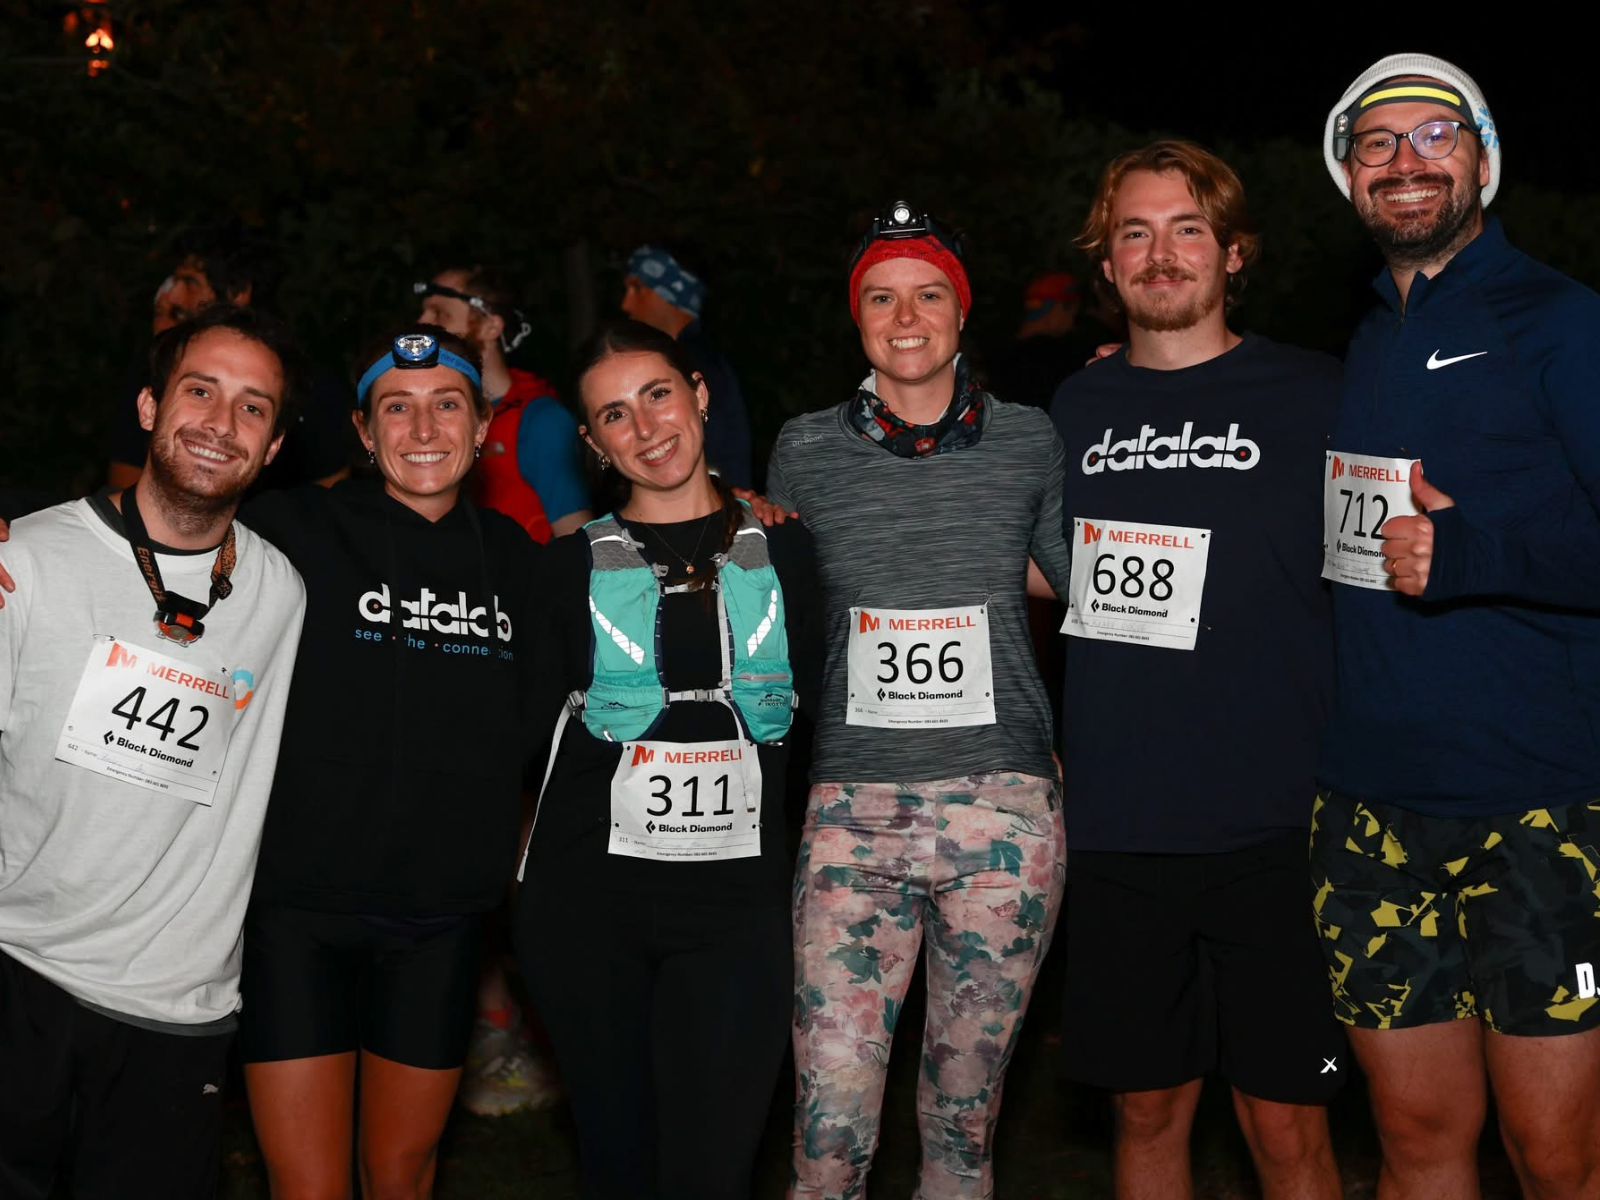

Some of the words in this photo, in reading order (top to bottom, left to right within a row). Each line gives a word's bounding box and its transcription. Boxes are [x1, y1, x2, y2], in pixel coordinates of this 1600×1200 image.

[1081, 421, 1261, 476] datalab
[1348, 464, 1407, 483] MERRELL
[1340, 488, 1389, 540] 712
[1108, 529, 1195, 550] MERRELL
[1341, 543, 1357, 554] Black
[1357, 546, 1387, 559] Diamon
[1092, 553, 1175, 602] 688
[888, 615, 977, 631] MERRELL
[1101, 602, 1127, 615] Black
[1128, 605, 1169, 619] Diamond
[355, 628, 383, 642] see
[404, 633, 426, 649] he
[442, 642, 514, 662] conneion
[876, 640, 964, 685] 366
[146, 661, 230, 700] MERRELL
[888, 690, 916, 700] Black
[917, 689, 963, 700] Diamond
[111, 685, 210, 752] 442
[116, 736, 148, 755] Black
[148, 747, 194, 769] Diamond
[646, 774, 734, 817] 311
[658, 824, 688, 833] Black
[689, 822, 733, 833] Diamond
